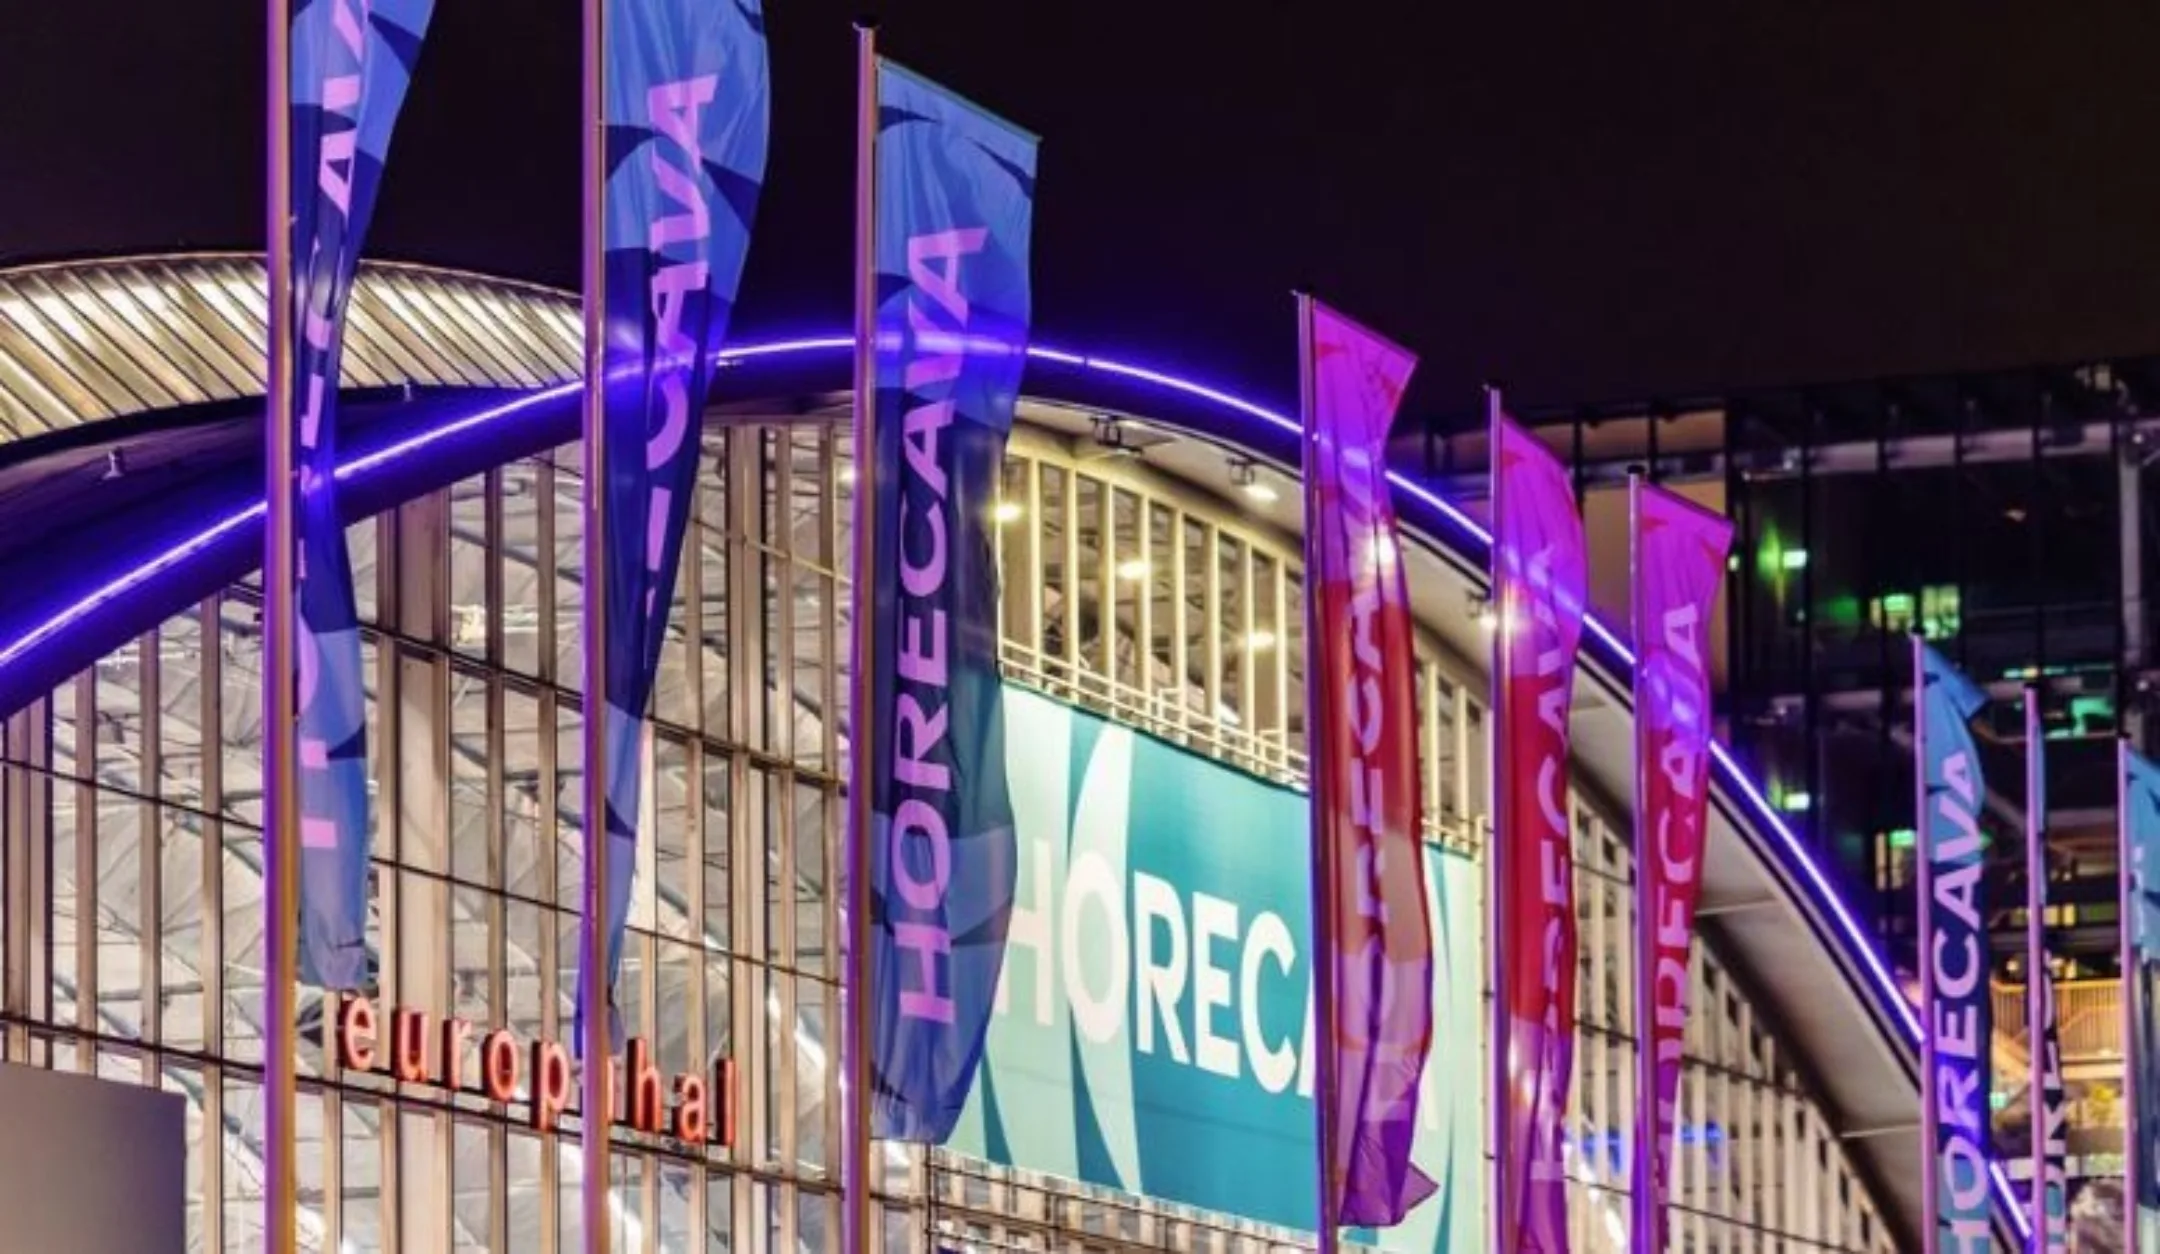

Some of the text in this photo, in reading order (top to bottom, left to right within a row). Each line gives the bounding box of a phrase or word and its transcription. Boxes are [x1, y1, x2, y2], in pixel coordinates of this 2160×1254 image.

[890, 226, 988, 1025] HORECAVA
[338, 990, 738, 1146] europhal
[990, 838, 1316, 1098] HOREC
